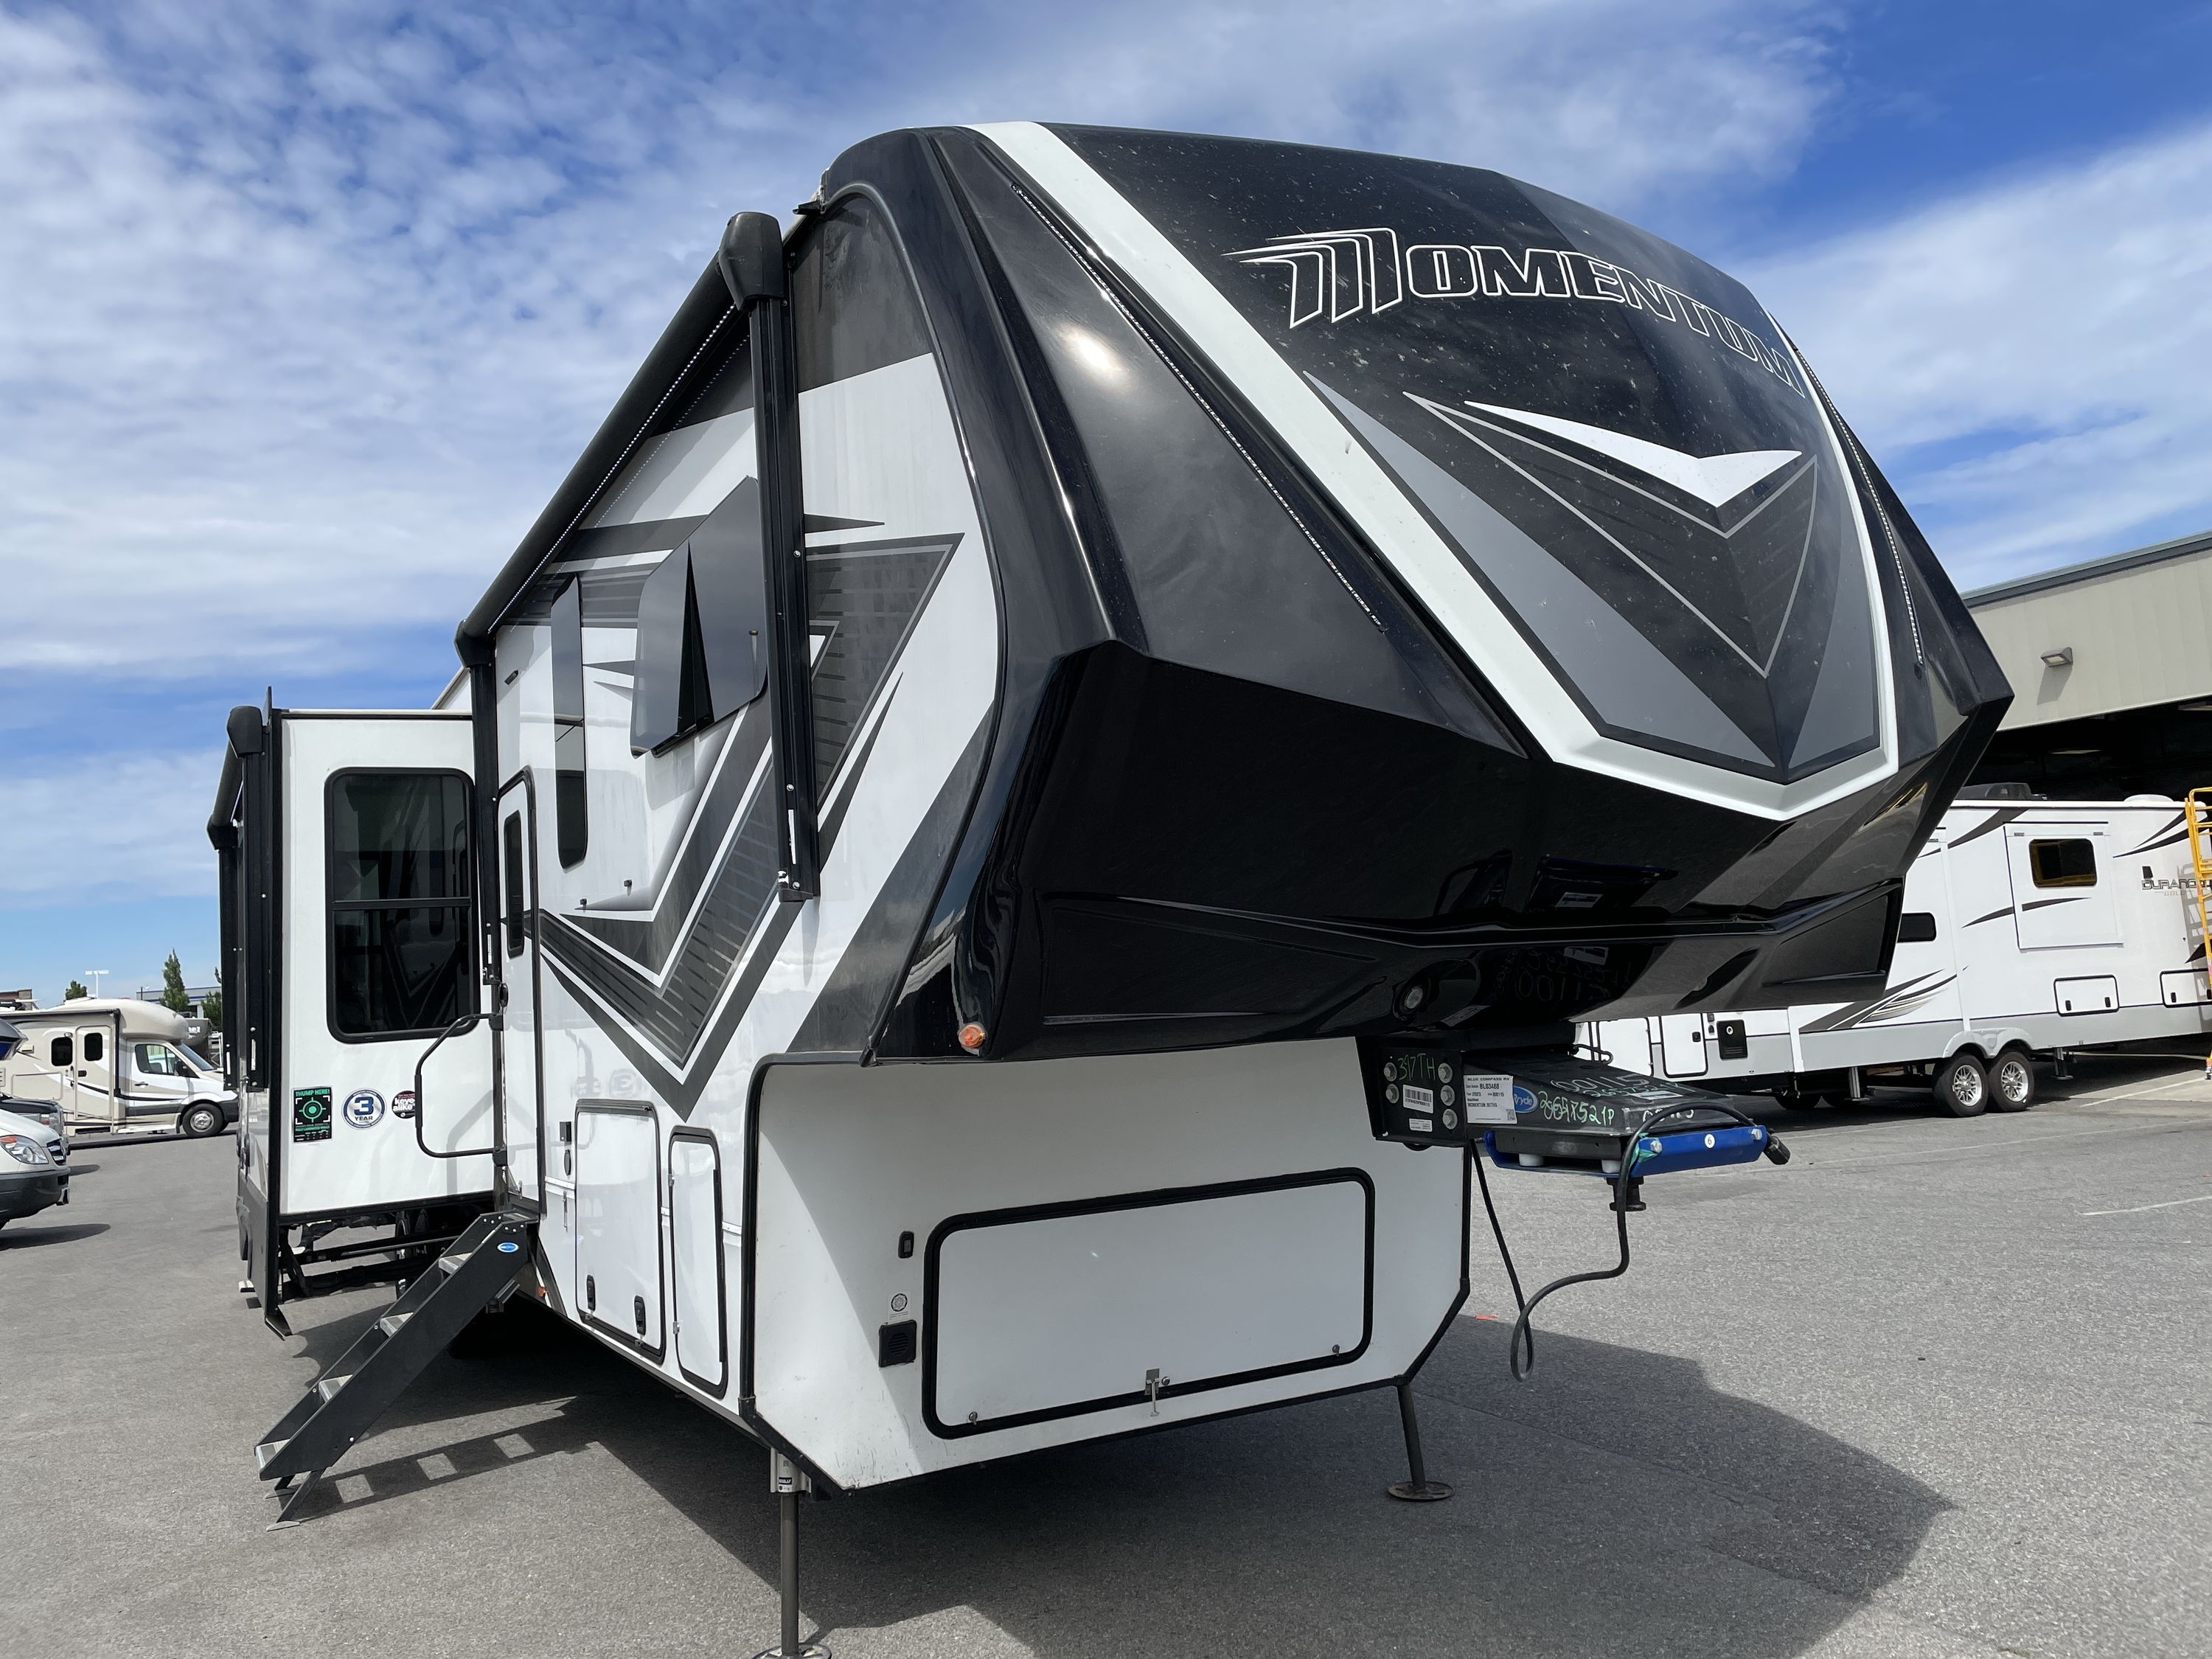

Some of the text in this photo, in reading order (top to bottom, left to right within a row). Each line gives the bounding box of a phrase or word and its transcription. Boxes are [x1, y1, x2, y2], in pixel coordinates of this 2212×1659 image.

[1222, 227, 1806, 399] MOMENTUM
[354, 1096, 374, 1116] 3
[1708, 1136, 1712, 1145] 6
